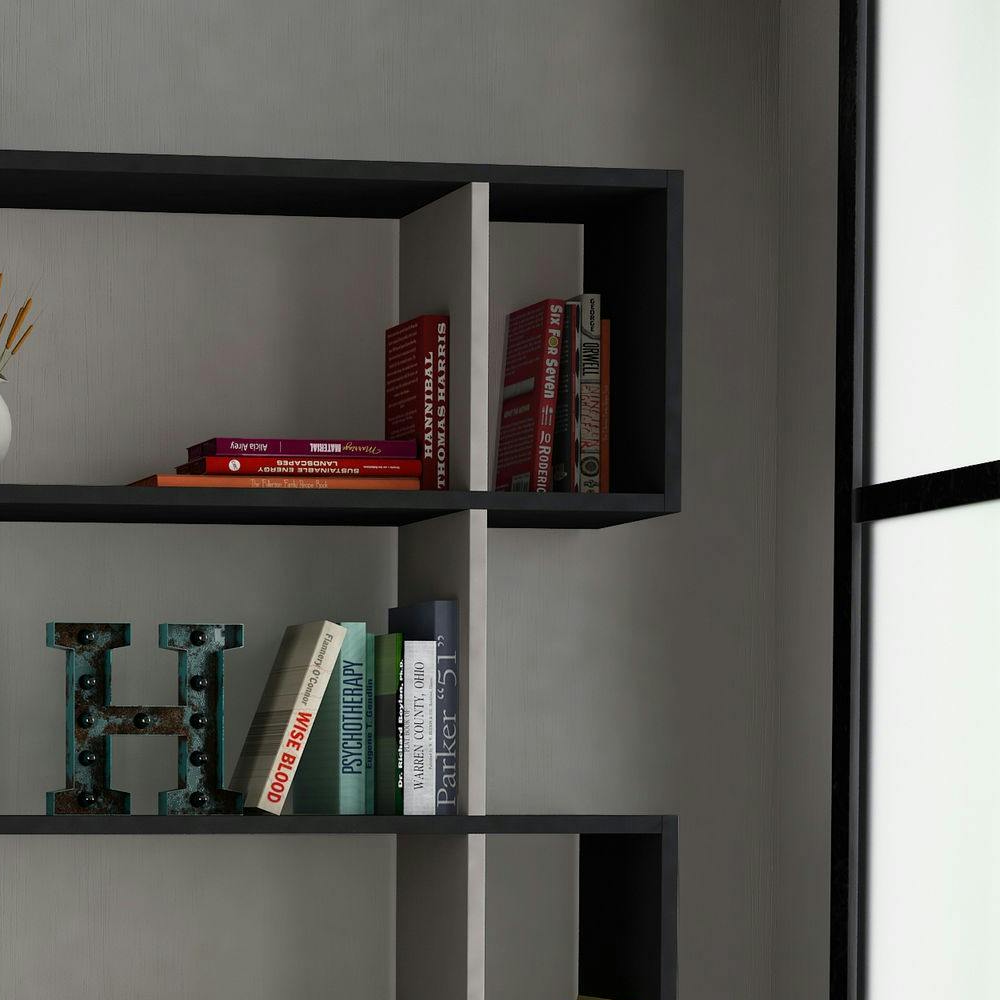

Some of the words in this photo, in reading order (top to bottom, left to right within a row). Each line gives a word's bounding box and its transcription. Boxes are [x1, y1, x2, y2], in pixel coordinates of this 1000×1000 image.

[437, 322, 446, 403] HARRIS
[582, 342, 600, 376] ORWELL
[424, 351, 434, 459] HANNIBAL
[249, 443, 268, 452] Alicia
[309, 443, 342, 454] MATERIAL
[437, 405, 446, 489] THOMAS
[314, 633, 333, 671] Flannery
[413, 661, 425, 689] OHIO
[302, 669, 321, 706] O'Connor
[46, 622, 244, 815] H
[286, 711, 312, 752] WISE
[341, 660, 363, 774] PSYCHOTHERAPY
[413, 692, 425, 740] COUNTY,
[365, 732, 374, 769] Eugene
[413, 744, 424, 790] WARREN
[435, 709, 457, 808] Parker
[267, 752, 296, 804] BLOOD
